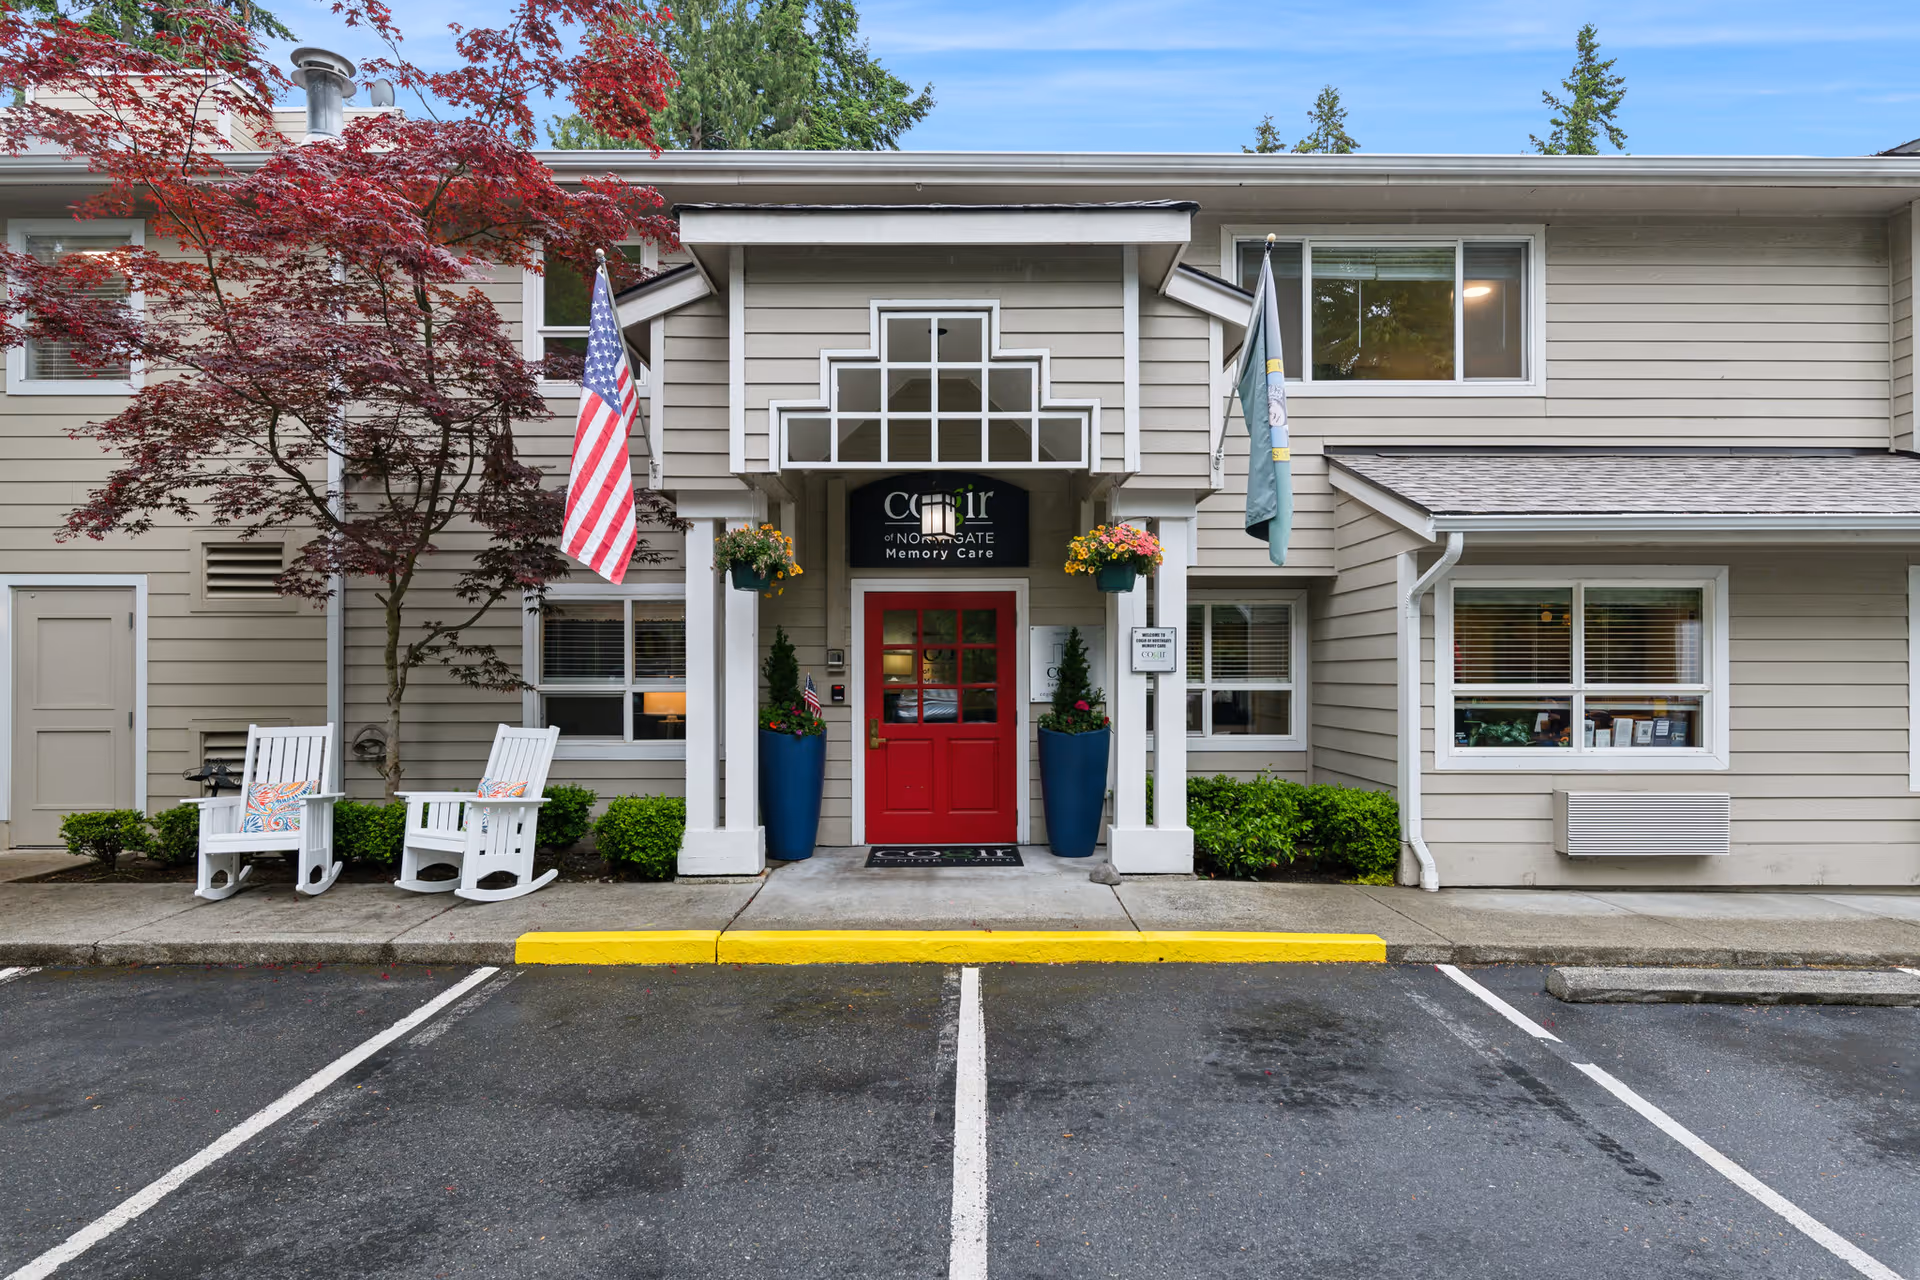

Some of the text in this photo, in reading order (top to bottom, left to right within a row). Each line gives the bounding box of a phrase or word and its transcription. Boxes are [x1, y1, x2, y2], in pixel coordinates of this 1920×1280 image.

[897, 532, 995, 544] NORGATE
[886, 548, 994, 560] Memory Care
